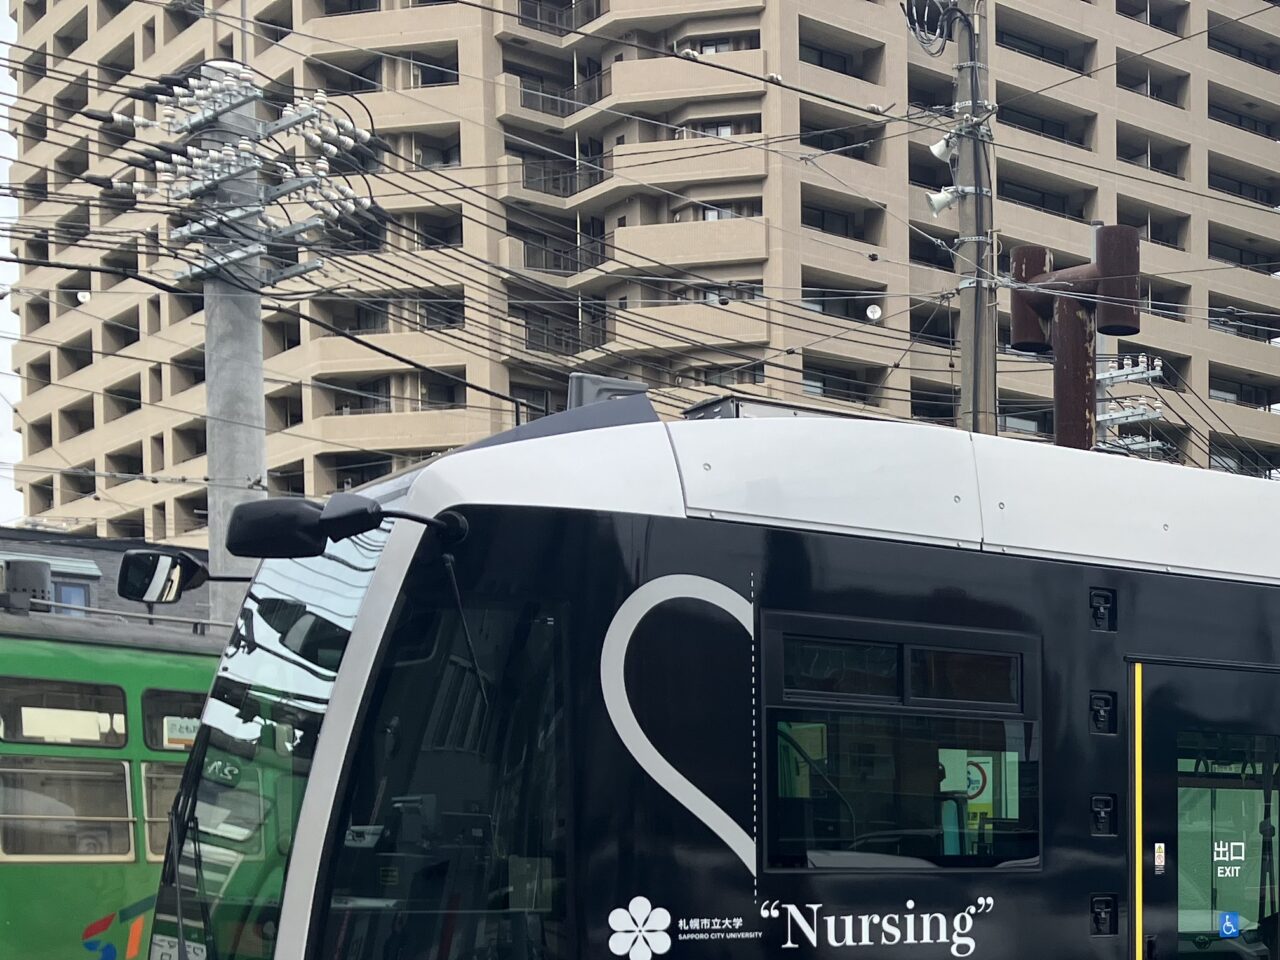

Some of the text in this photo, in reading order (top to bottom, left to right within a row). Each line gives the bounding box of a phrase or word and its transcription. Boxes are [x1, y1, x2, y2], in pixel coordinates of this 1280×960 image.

[1213, 840, 1245, 861] 出口
[1217, 866, 1241, 877] EXIT
[678, 917, 743, 930] 札幌市立大学
[678, 932, 709, 940] SAPPORO
[726, 931, 763, 939] UNIVERSITY
